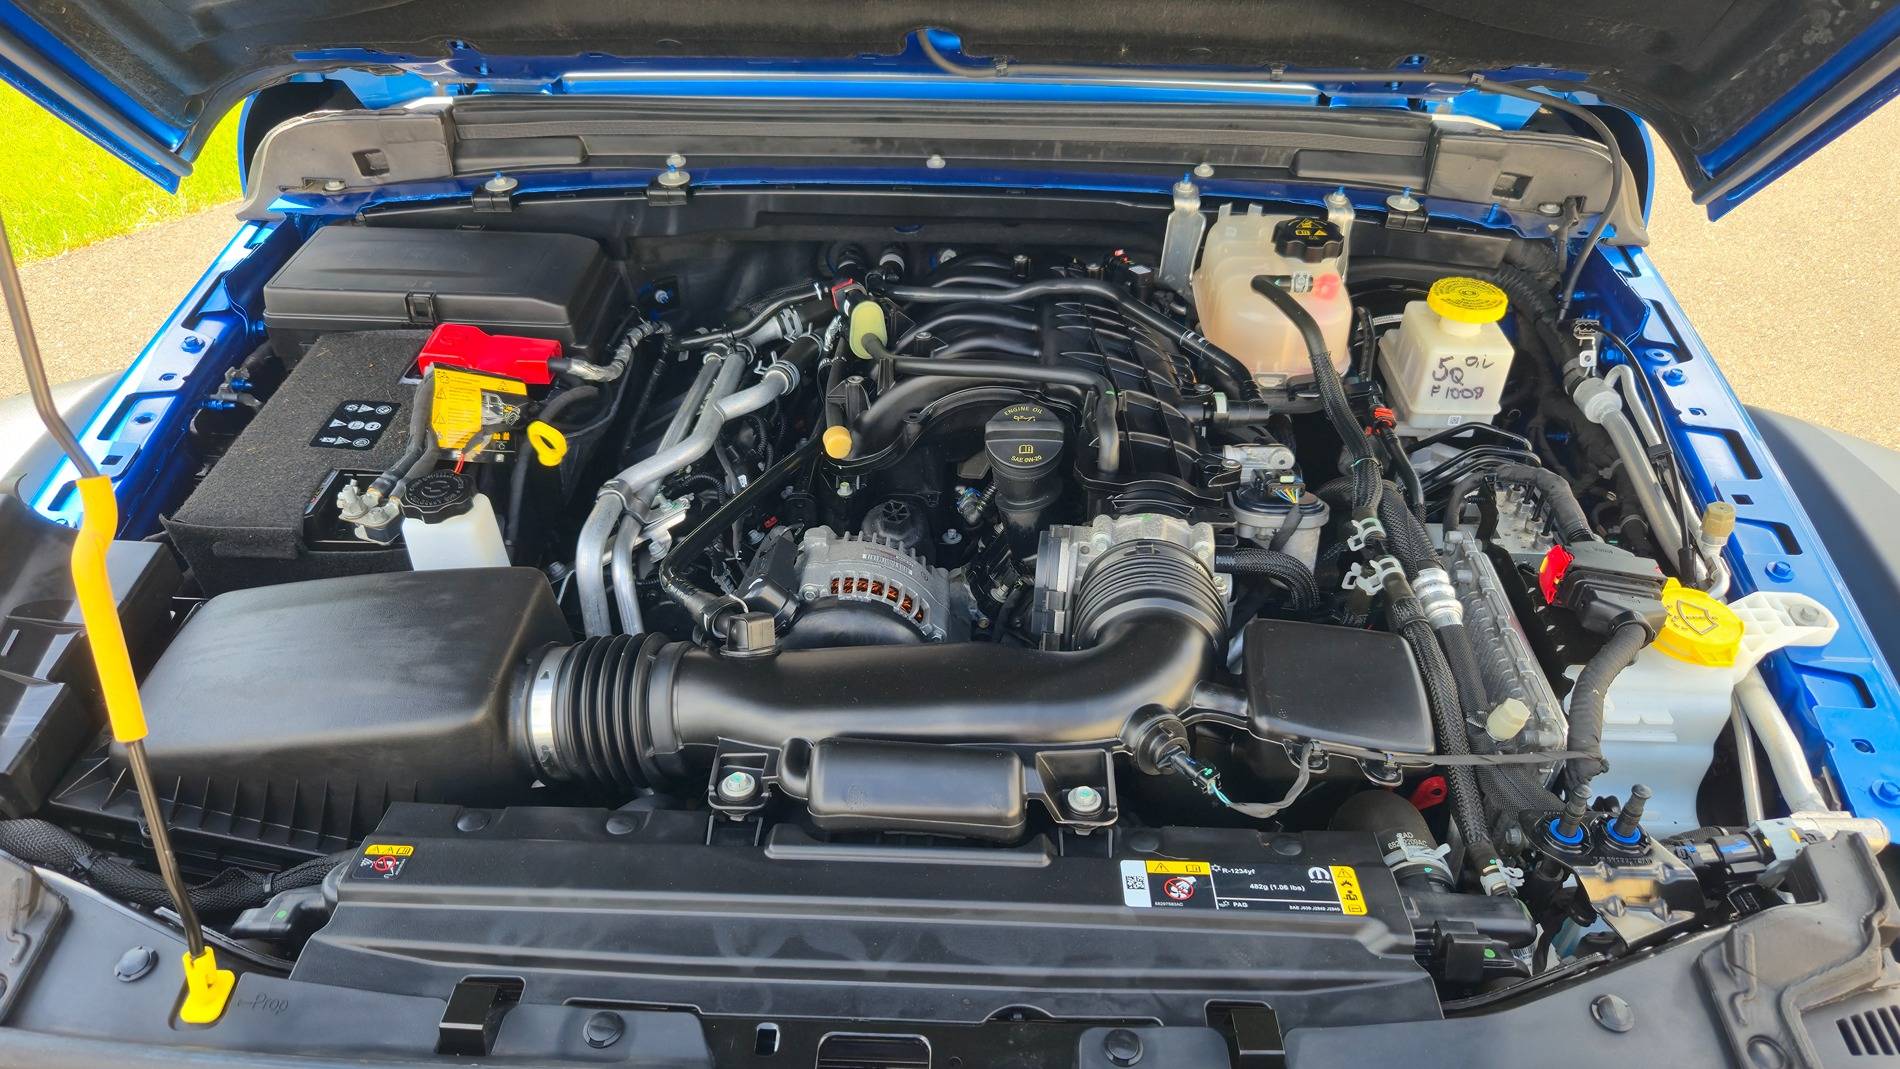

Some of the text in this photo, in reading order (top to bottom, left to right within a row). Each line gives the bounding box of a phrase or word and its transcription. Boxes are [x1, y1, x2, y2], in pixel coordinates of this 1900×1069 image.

[1004, 406, 1043, 416] ENGINE OIL
[1222, 867, 1256, 876] R-1234yf
[1290, 884, 1306, 892] lbs)
